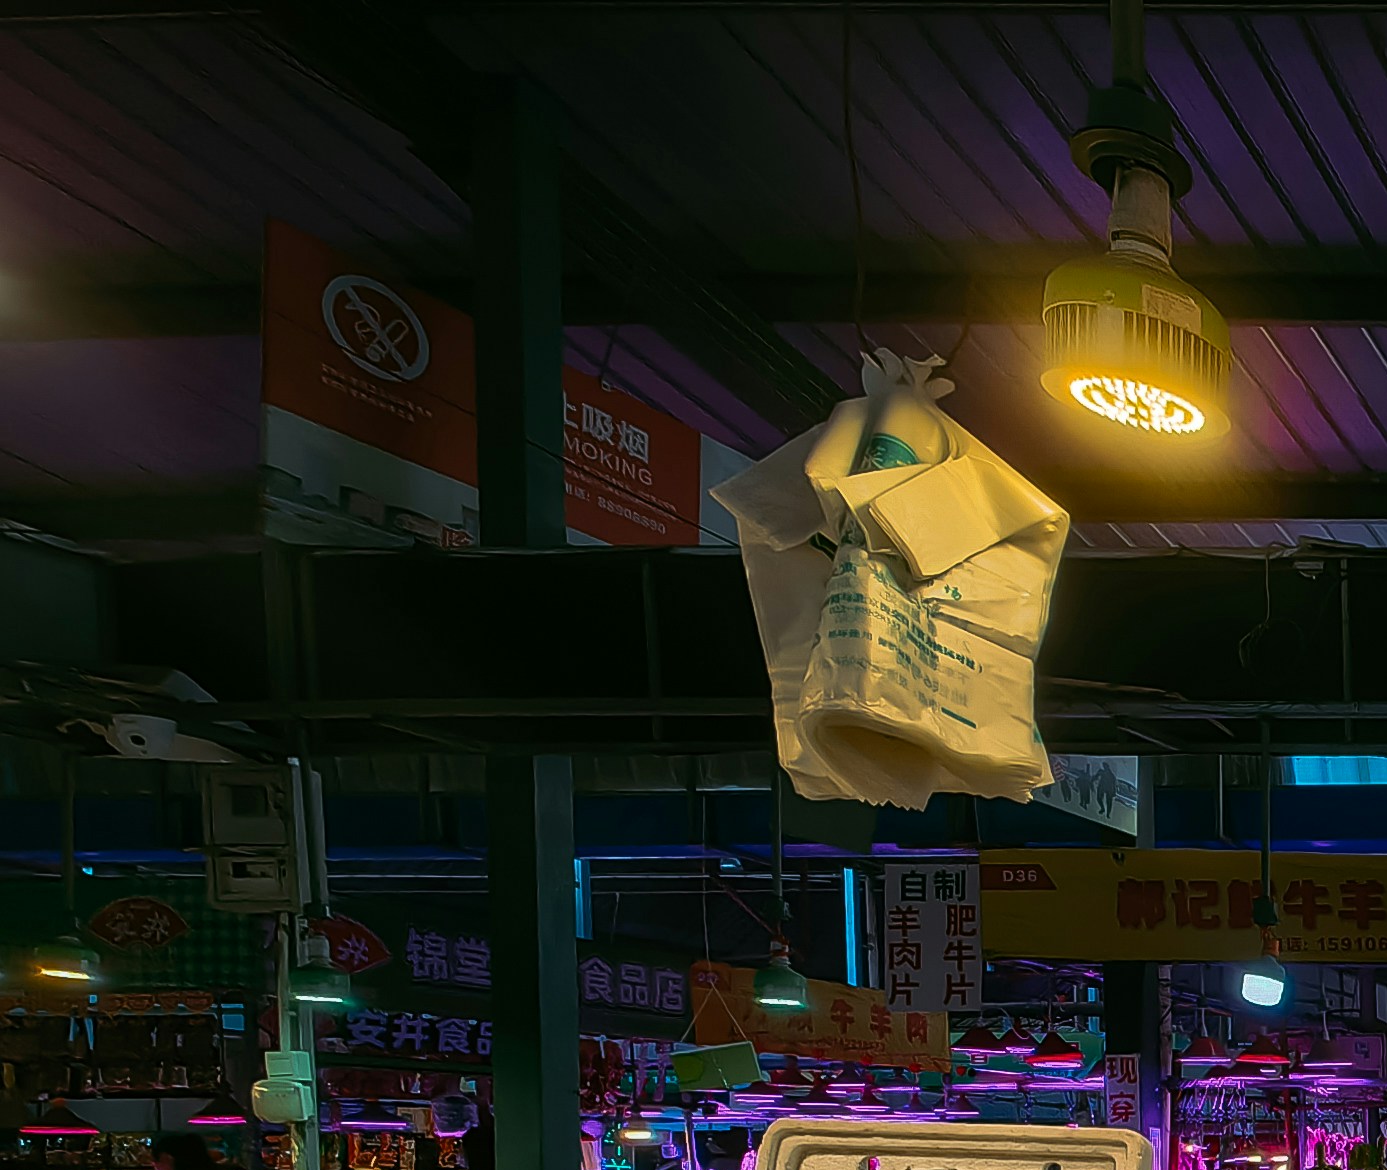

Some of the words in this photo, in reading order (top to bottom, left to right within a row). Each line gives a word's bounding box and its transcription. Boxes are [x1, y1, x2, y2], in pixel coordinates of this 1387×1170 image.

[900, 869, 967, 902] 自制
[1002, 869, 1038, 883] D36
[579, 954, 687, 1019] 食品店
[888, 905, 922, 1006] 羊肉片
[944, 904, 978, 1006] 肥牛片
